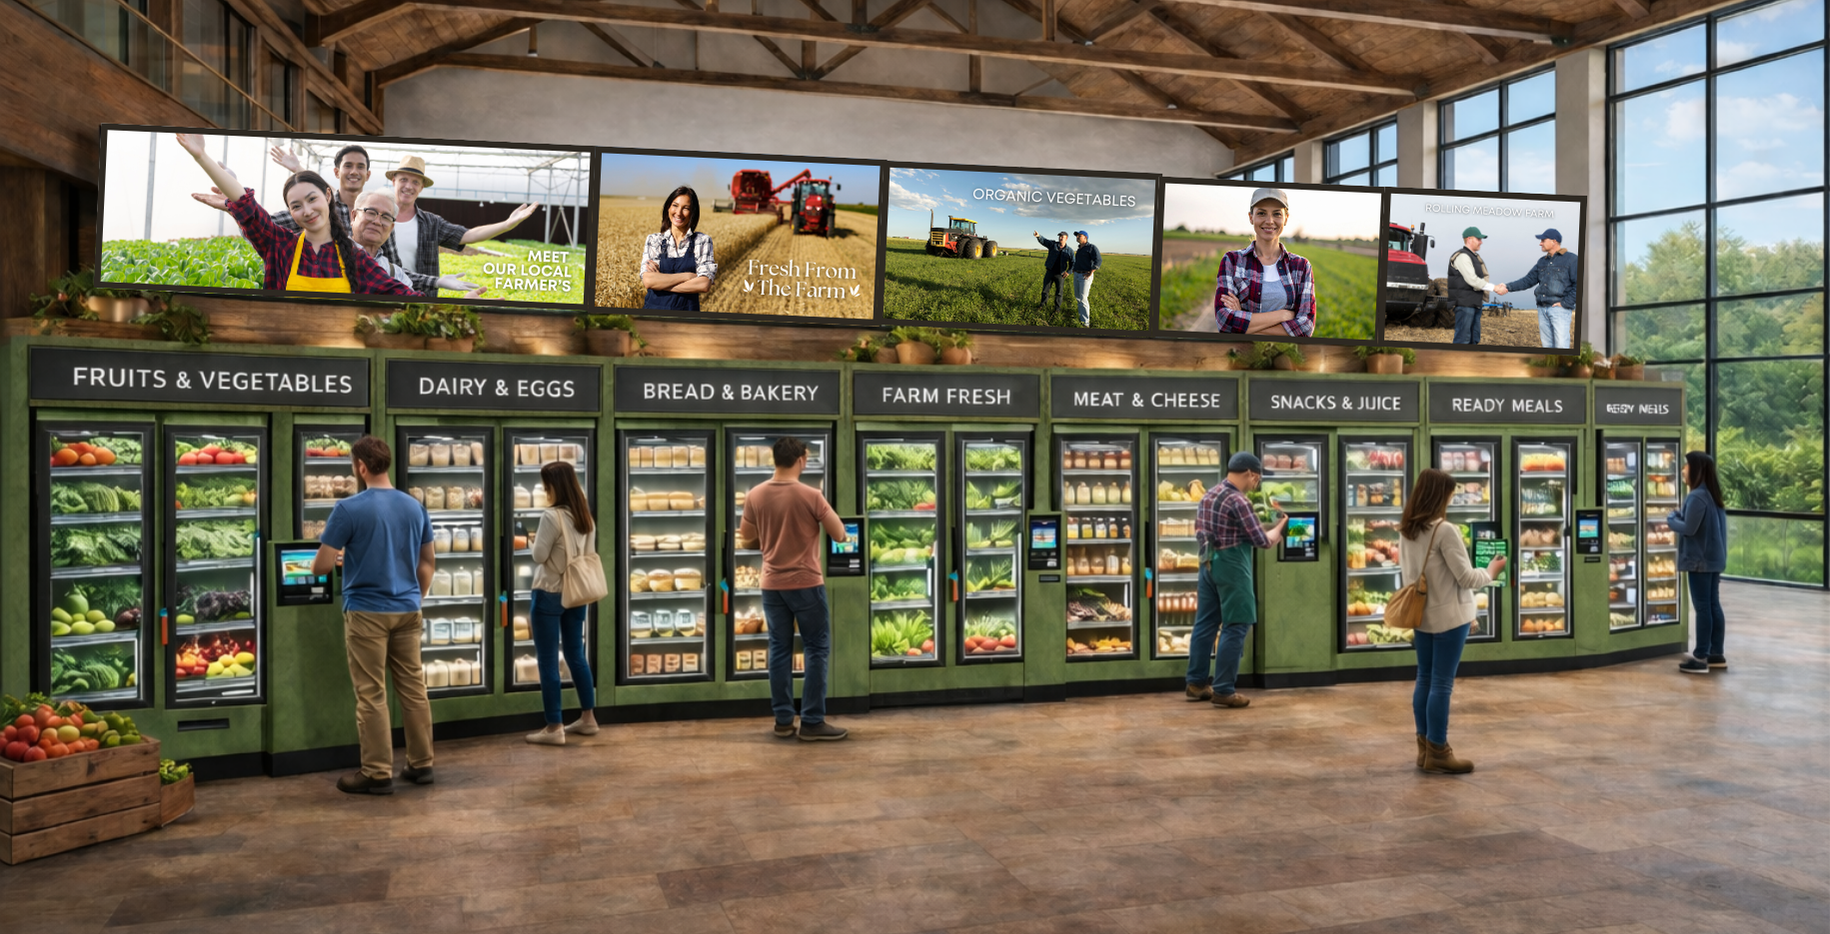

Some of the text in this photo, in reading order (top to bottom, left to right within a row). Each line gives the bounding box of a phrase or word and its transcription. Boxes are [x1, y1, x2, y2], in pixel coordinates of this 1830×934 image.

[972, 187, 1137, 208] ORGANIC VEGETABLES
[1425, 203, 1555, 219] ROLLING MEADOW FARM
[527, 250, 570, 264] MEET
[483, 262, 572, 278] OUR LOCAL
[748, 258, 857, 280] Fresh From
[495, 277, 572, 292] FARMER'S
[757, 277, 846, 299] The Farm
[73, 366, 353, 394] FRUITS & VEGETABLES
[419, 376, 575, 398] DAIRY & EGGS
[643, 382, 819, 402] BREAD & BAKERY
[882, 386, 1011, 405] FARM FRESH
[1073, 391, 1221, 409] MEAT & CHEESE
[1270, 394, 1401, 411] SNACKS & JUICE
[1452, 397, 1563, 414] READY MEALS
